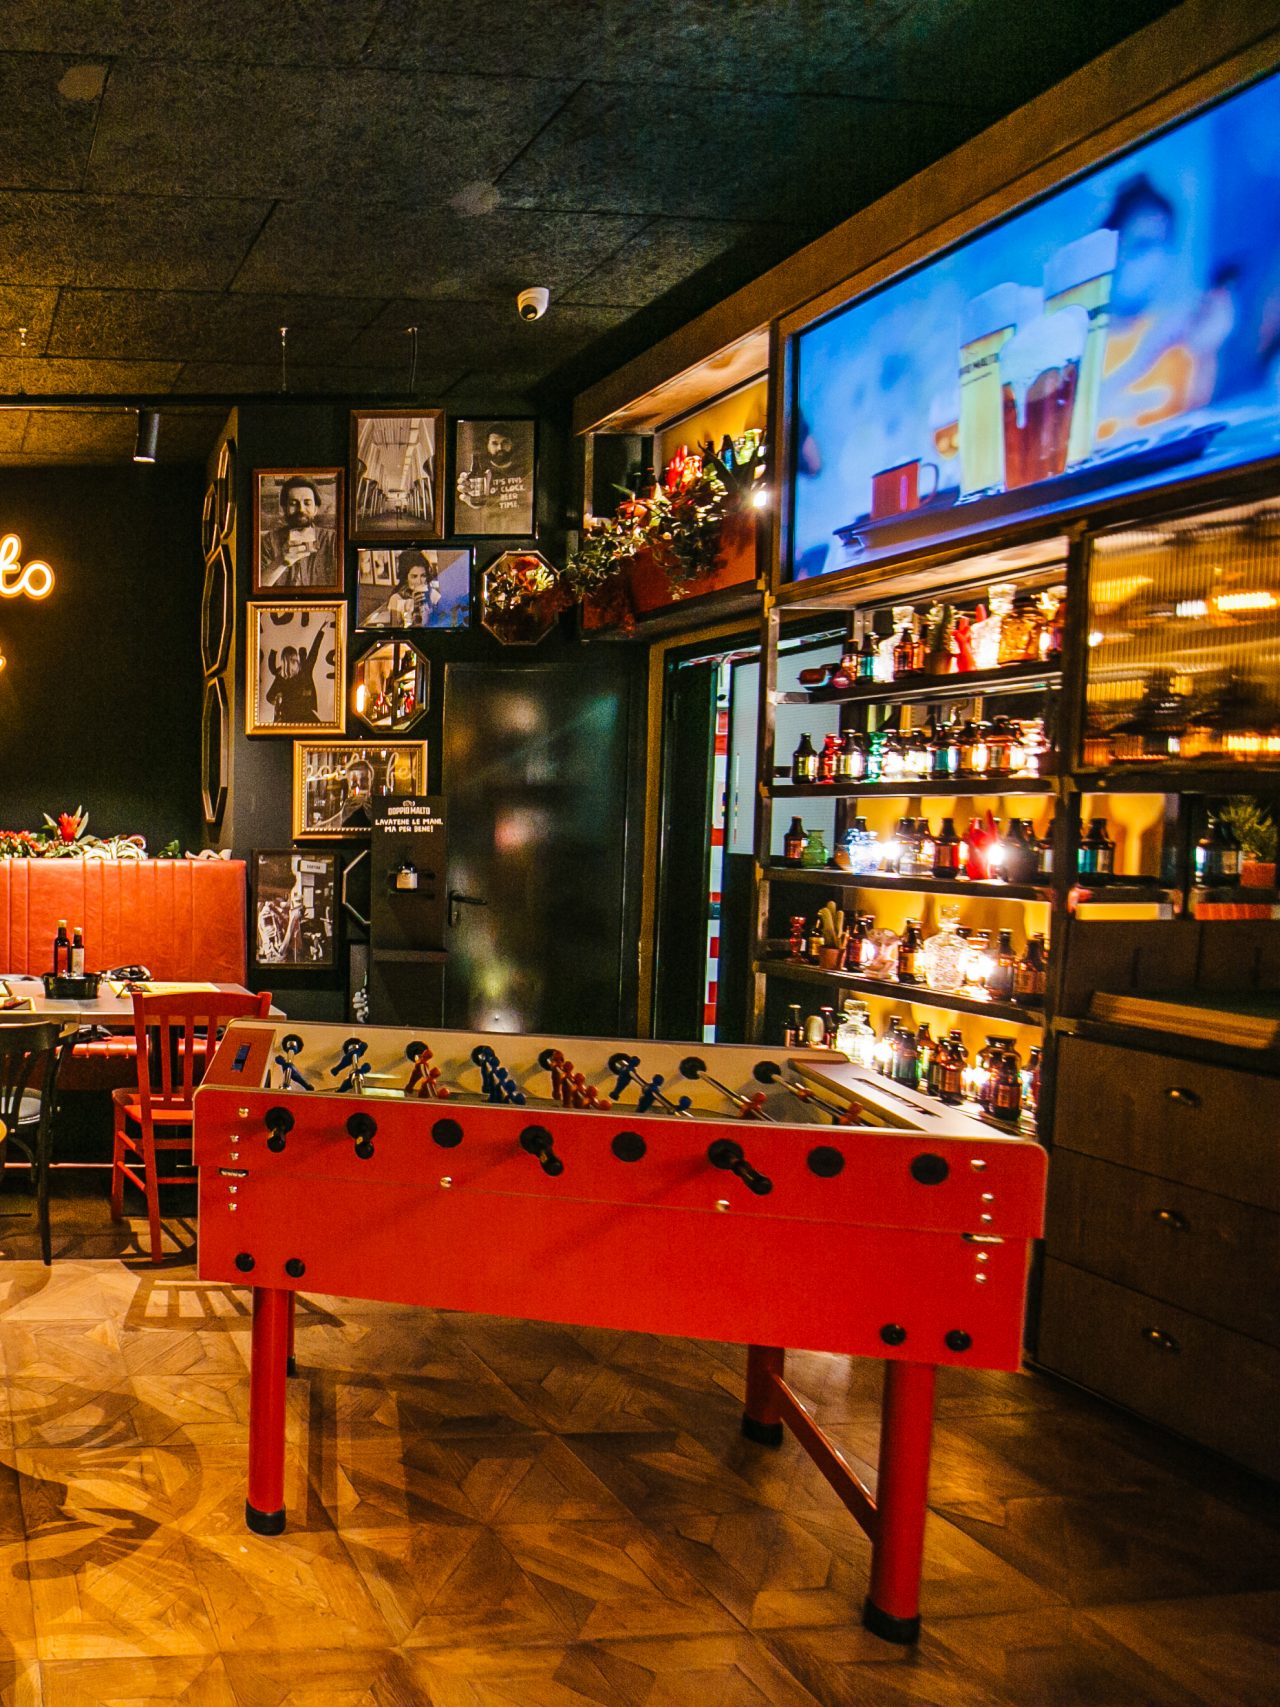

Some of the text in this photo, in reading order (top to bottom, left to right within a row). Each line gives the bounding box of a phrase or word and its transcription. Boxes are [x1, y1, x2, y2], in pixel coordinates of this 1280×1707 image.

[387, 806, 431, 816] DOPPIO MALTO
[384, 825, 434, 833] MA PER BENE!
